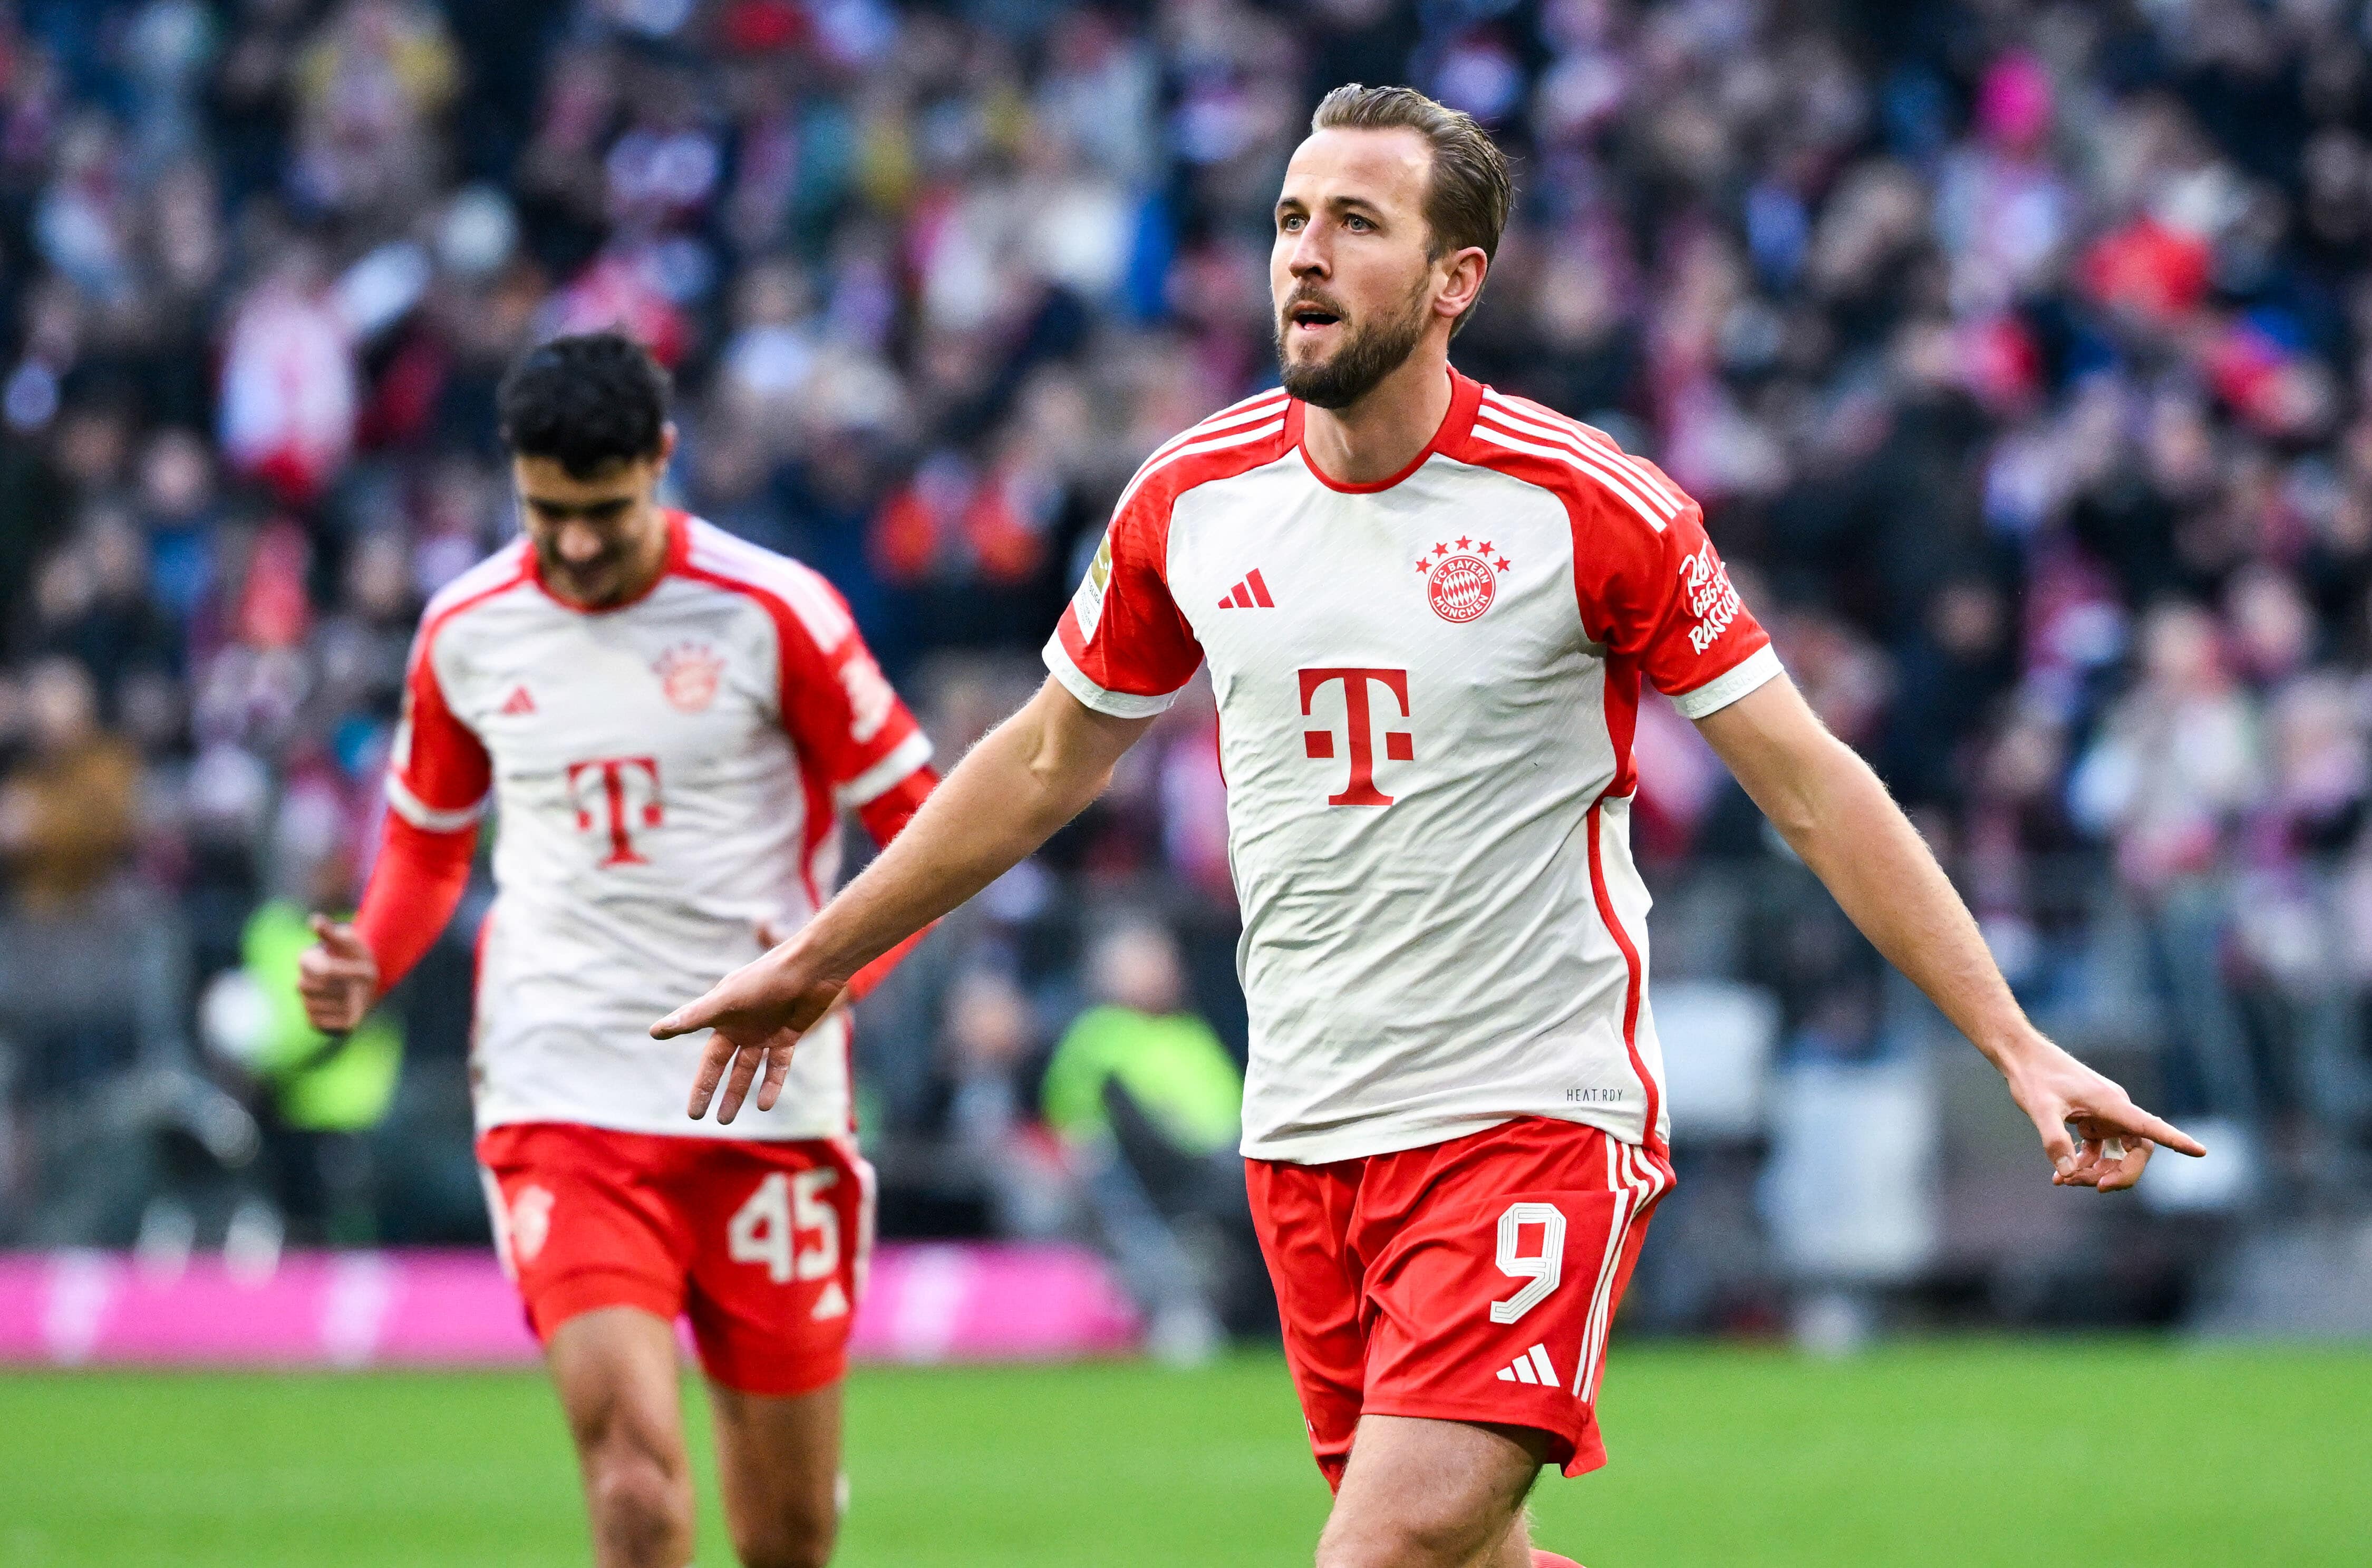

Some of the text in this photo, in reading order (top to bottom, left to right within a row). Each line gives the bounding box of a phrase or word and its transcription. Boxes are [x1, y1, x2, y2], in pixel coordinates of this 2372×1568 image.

[1434, 560, 1490, 585] FC BAYERN
[1434, 594, 1489, 618] MÜNCHEN
[1679, 538, 1714, 597] ROT
[1298, 667, 1413, 806] T
[566, 755, 664, 869] T
[1566, 1088, 1623, 1101] HEAT.RDY
[727, 1166, 840, 1284] 45
[1490, 1203, 1566, 1324] 9
